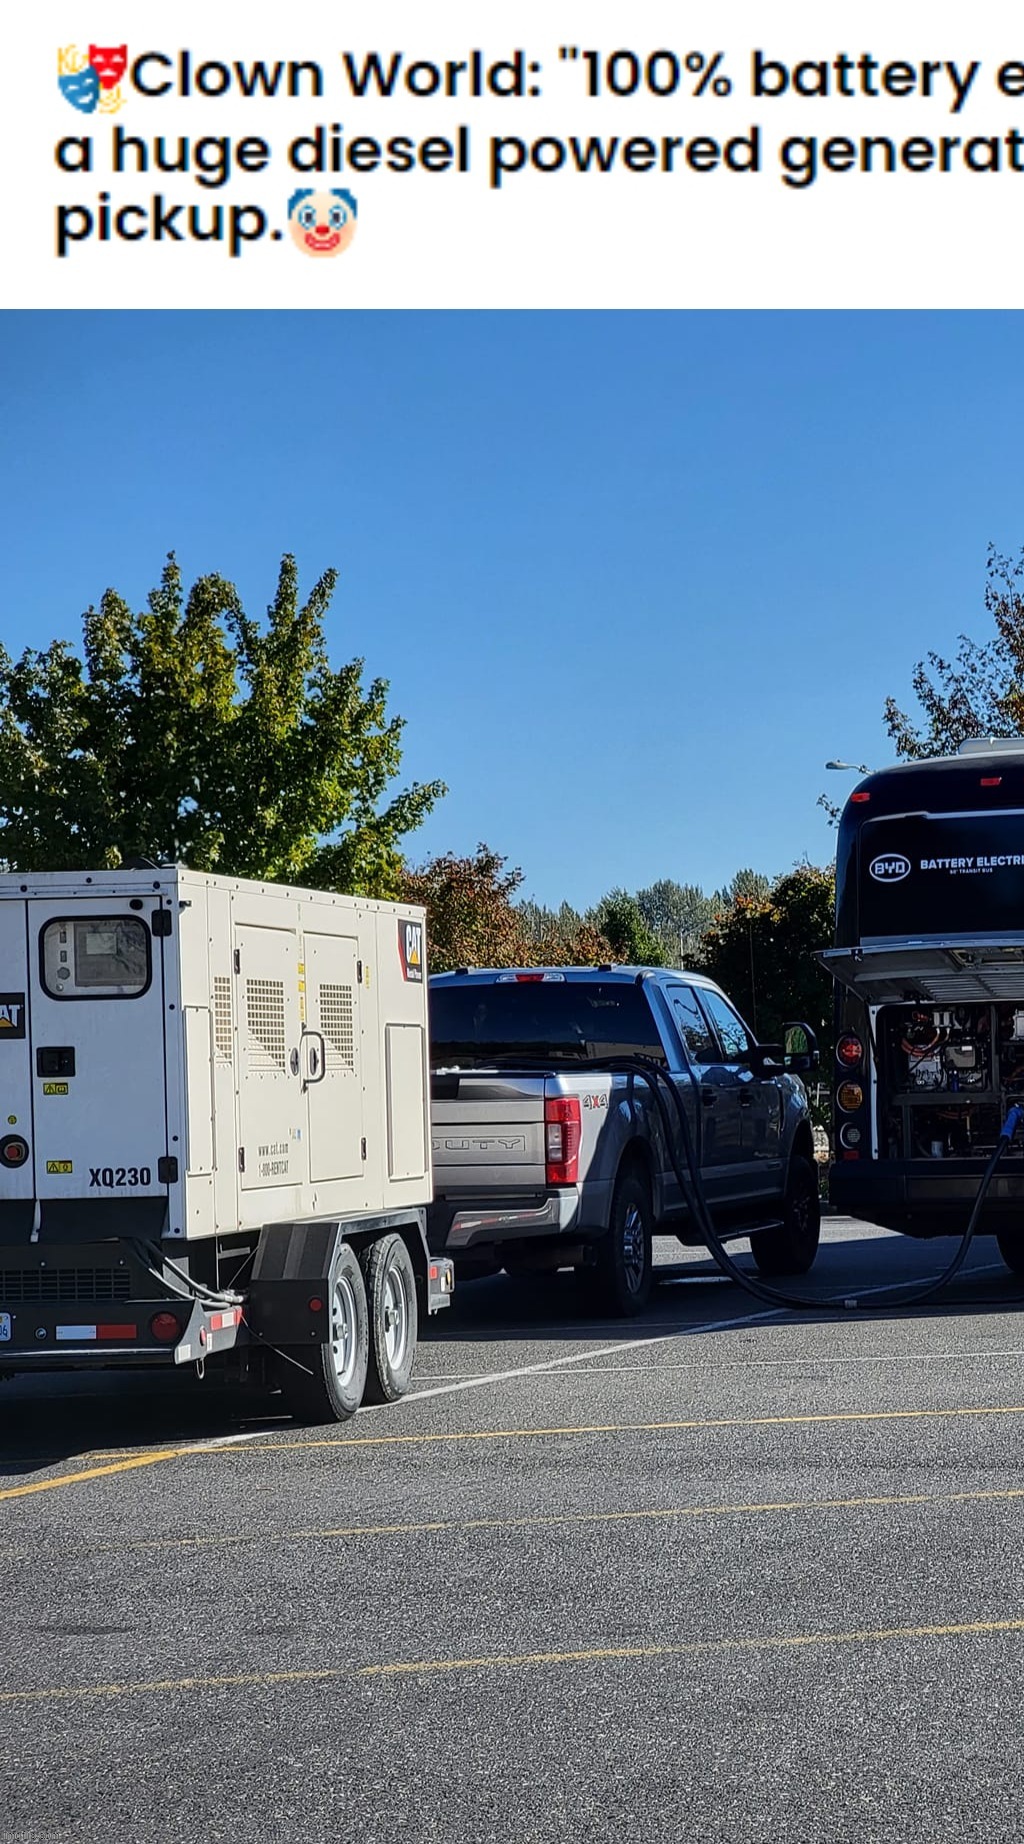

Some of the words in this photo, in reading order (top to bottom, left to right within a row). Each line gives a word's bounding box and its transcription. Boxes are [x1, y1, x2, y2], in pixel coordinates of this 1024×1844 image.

[875, 861, 905, 875] BYD
[920, 857, 974, 870] BATTERY
[406, 925, 421, 965] CAT
[258, 1142, 289, 1157] www.cat.com
[89, 1167, 151, 1188] XQ230
